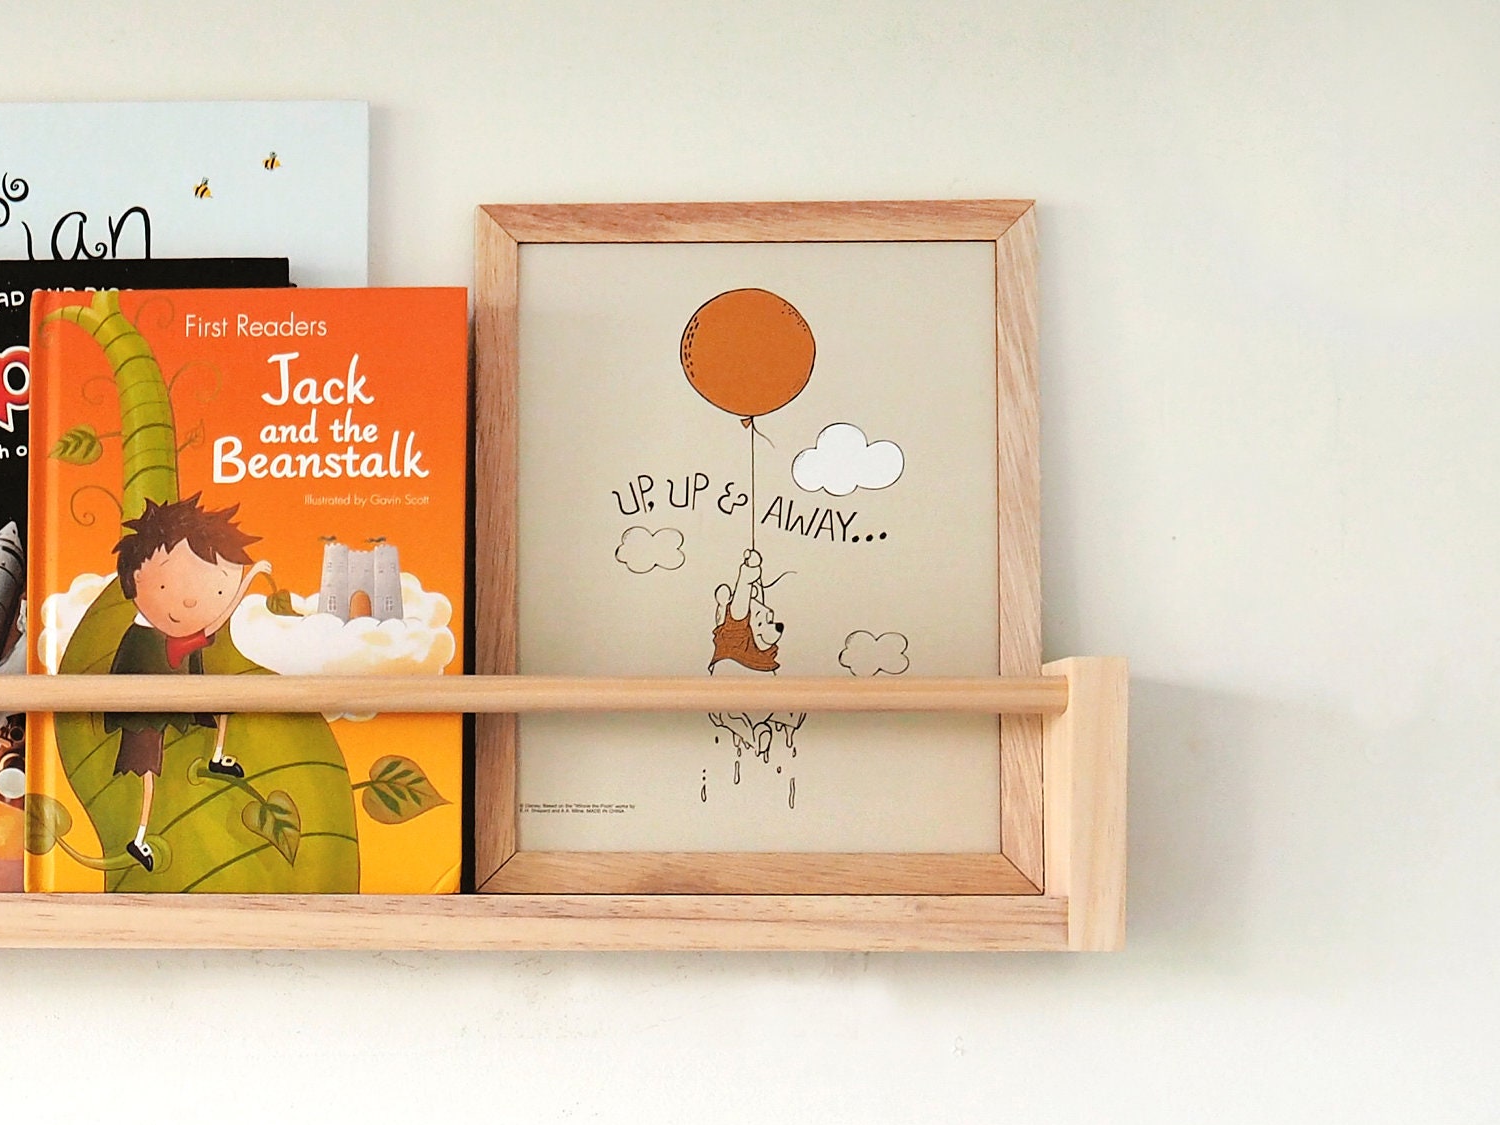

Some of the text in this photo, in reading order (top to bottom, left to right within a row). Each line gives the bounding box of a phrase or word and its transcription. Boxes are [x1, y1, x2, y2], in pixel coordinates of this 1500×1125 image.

[185, 311, 327, 338] First Readers
[261, 351, 375, 406] Jack
[259, 407, 379, 444] and the
[212, 429, 430, 484] Beanstalk
[611, 472, 888, 543] UP, UP & AWAY...
